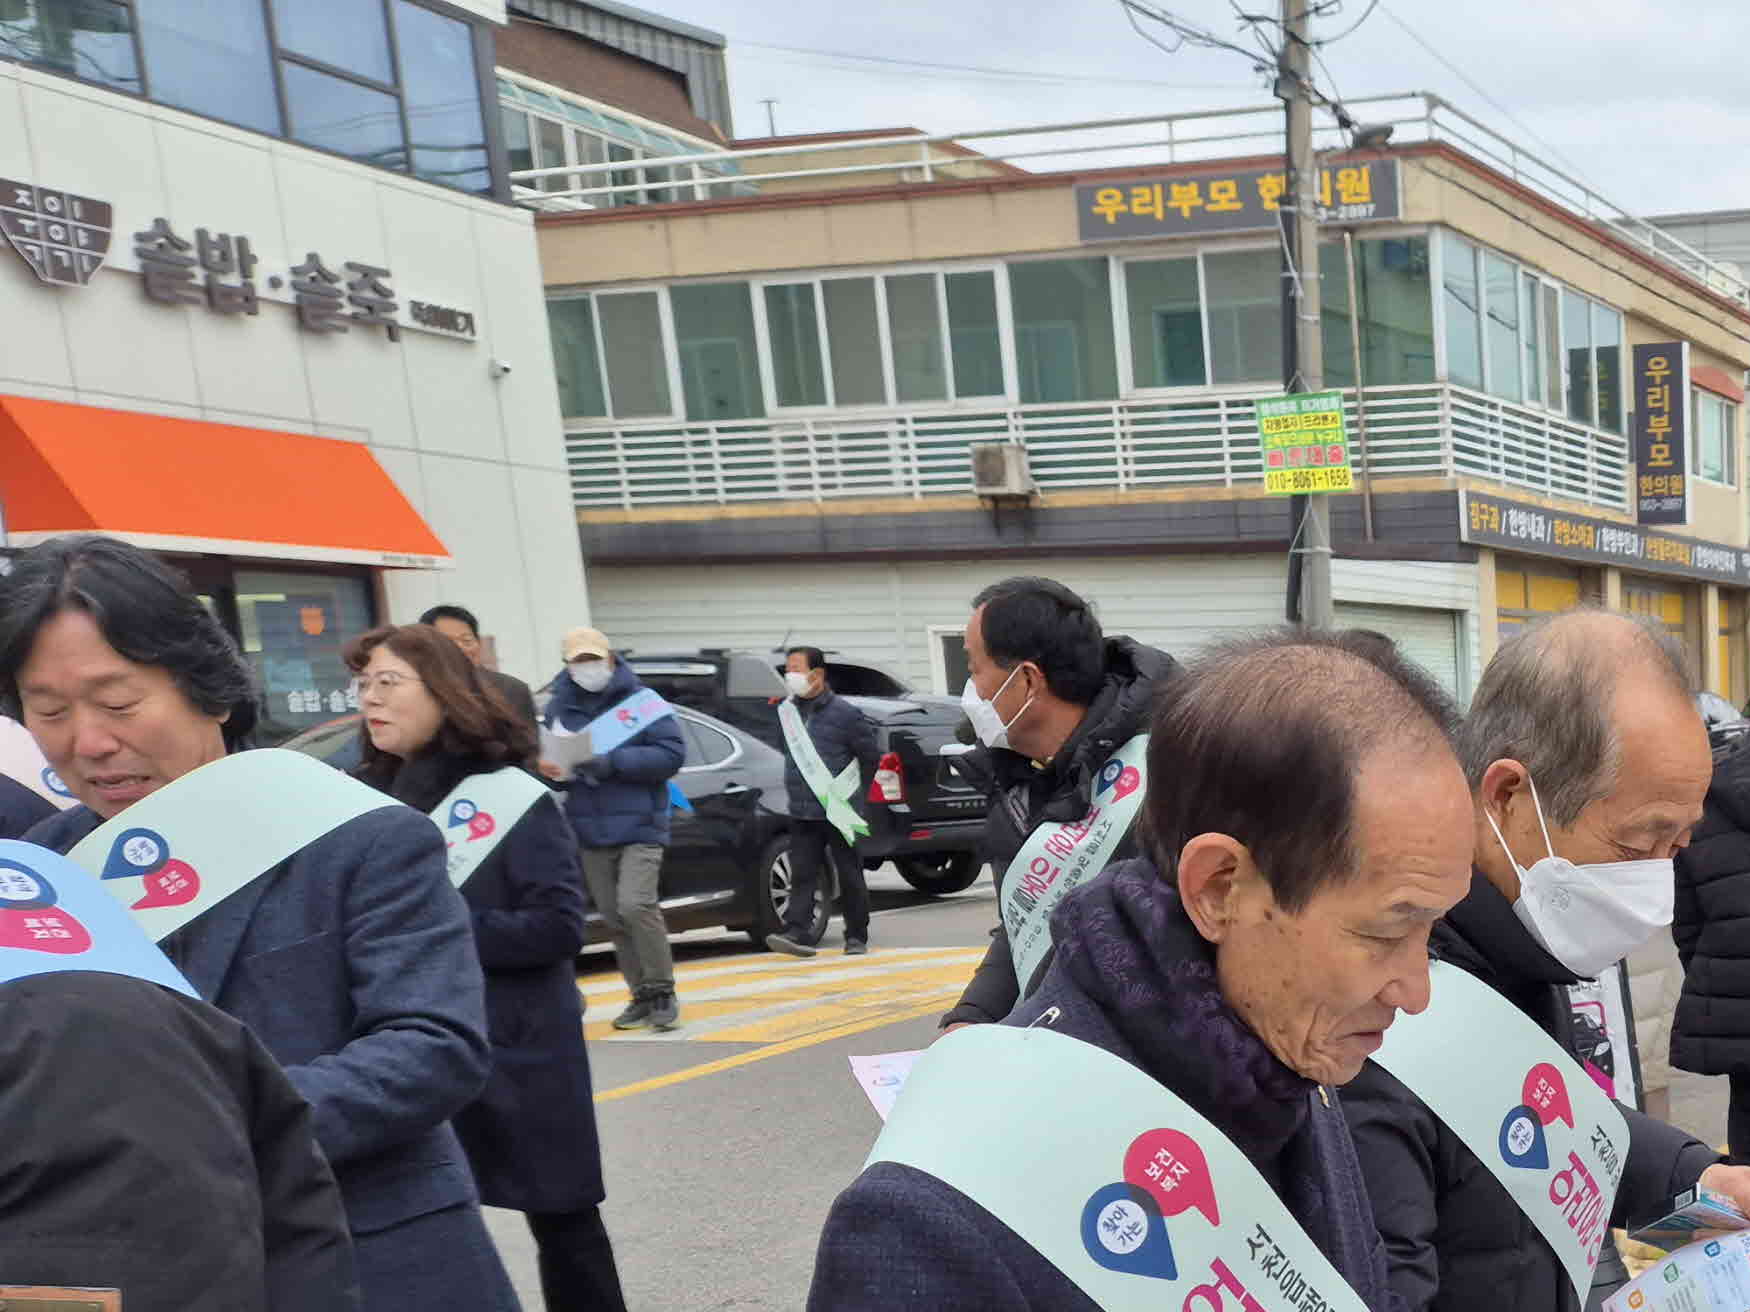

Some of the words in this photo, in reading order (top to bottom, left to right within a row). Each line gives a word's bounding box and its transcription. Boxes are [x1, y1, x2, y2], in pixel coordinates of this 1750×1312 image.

[1092, 179, 1244, 225] 우리부모
[1256, 166, 1372, 212] 한원
[1644, 356, 1673, 467] 우리부모
[1639, 474, 1684, 497] 한의원
[1508, 507, 1546, 543] 한방내과
[1143, 1147, 1172, 1184] 보건
[1160, 1161, 1190, 1193] 복지
[1102, 1205, 1129, 1238] 찾아
[1115, 1219, 1145, 1249] 가는
